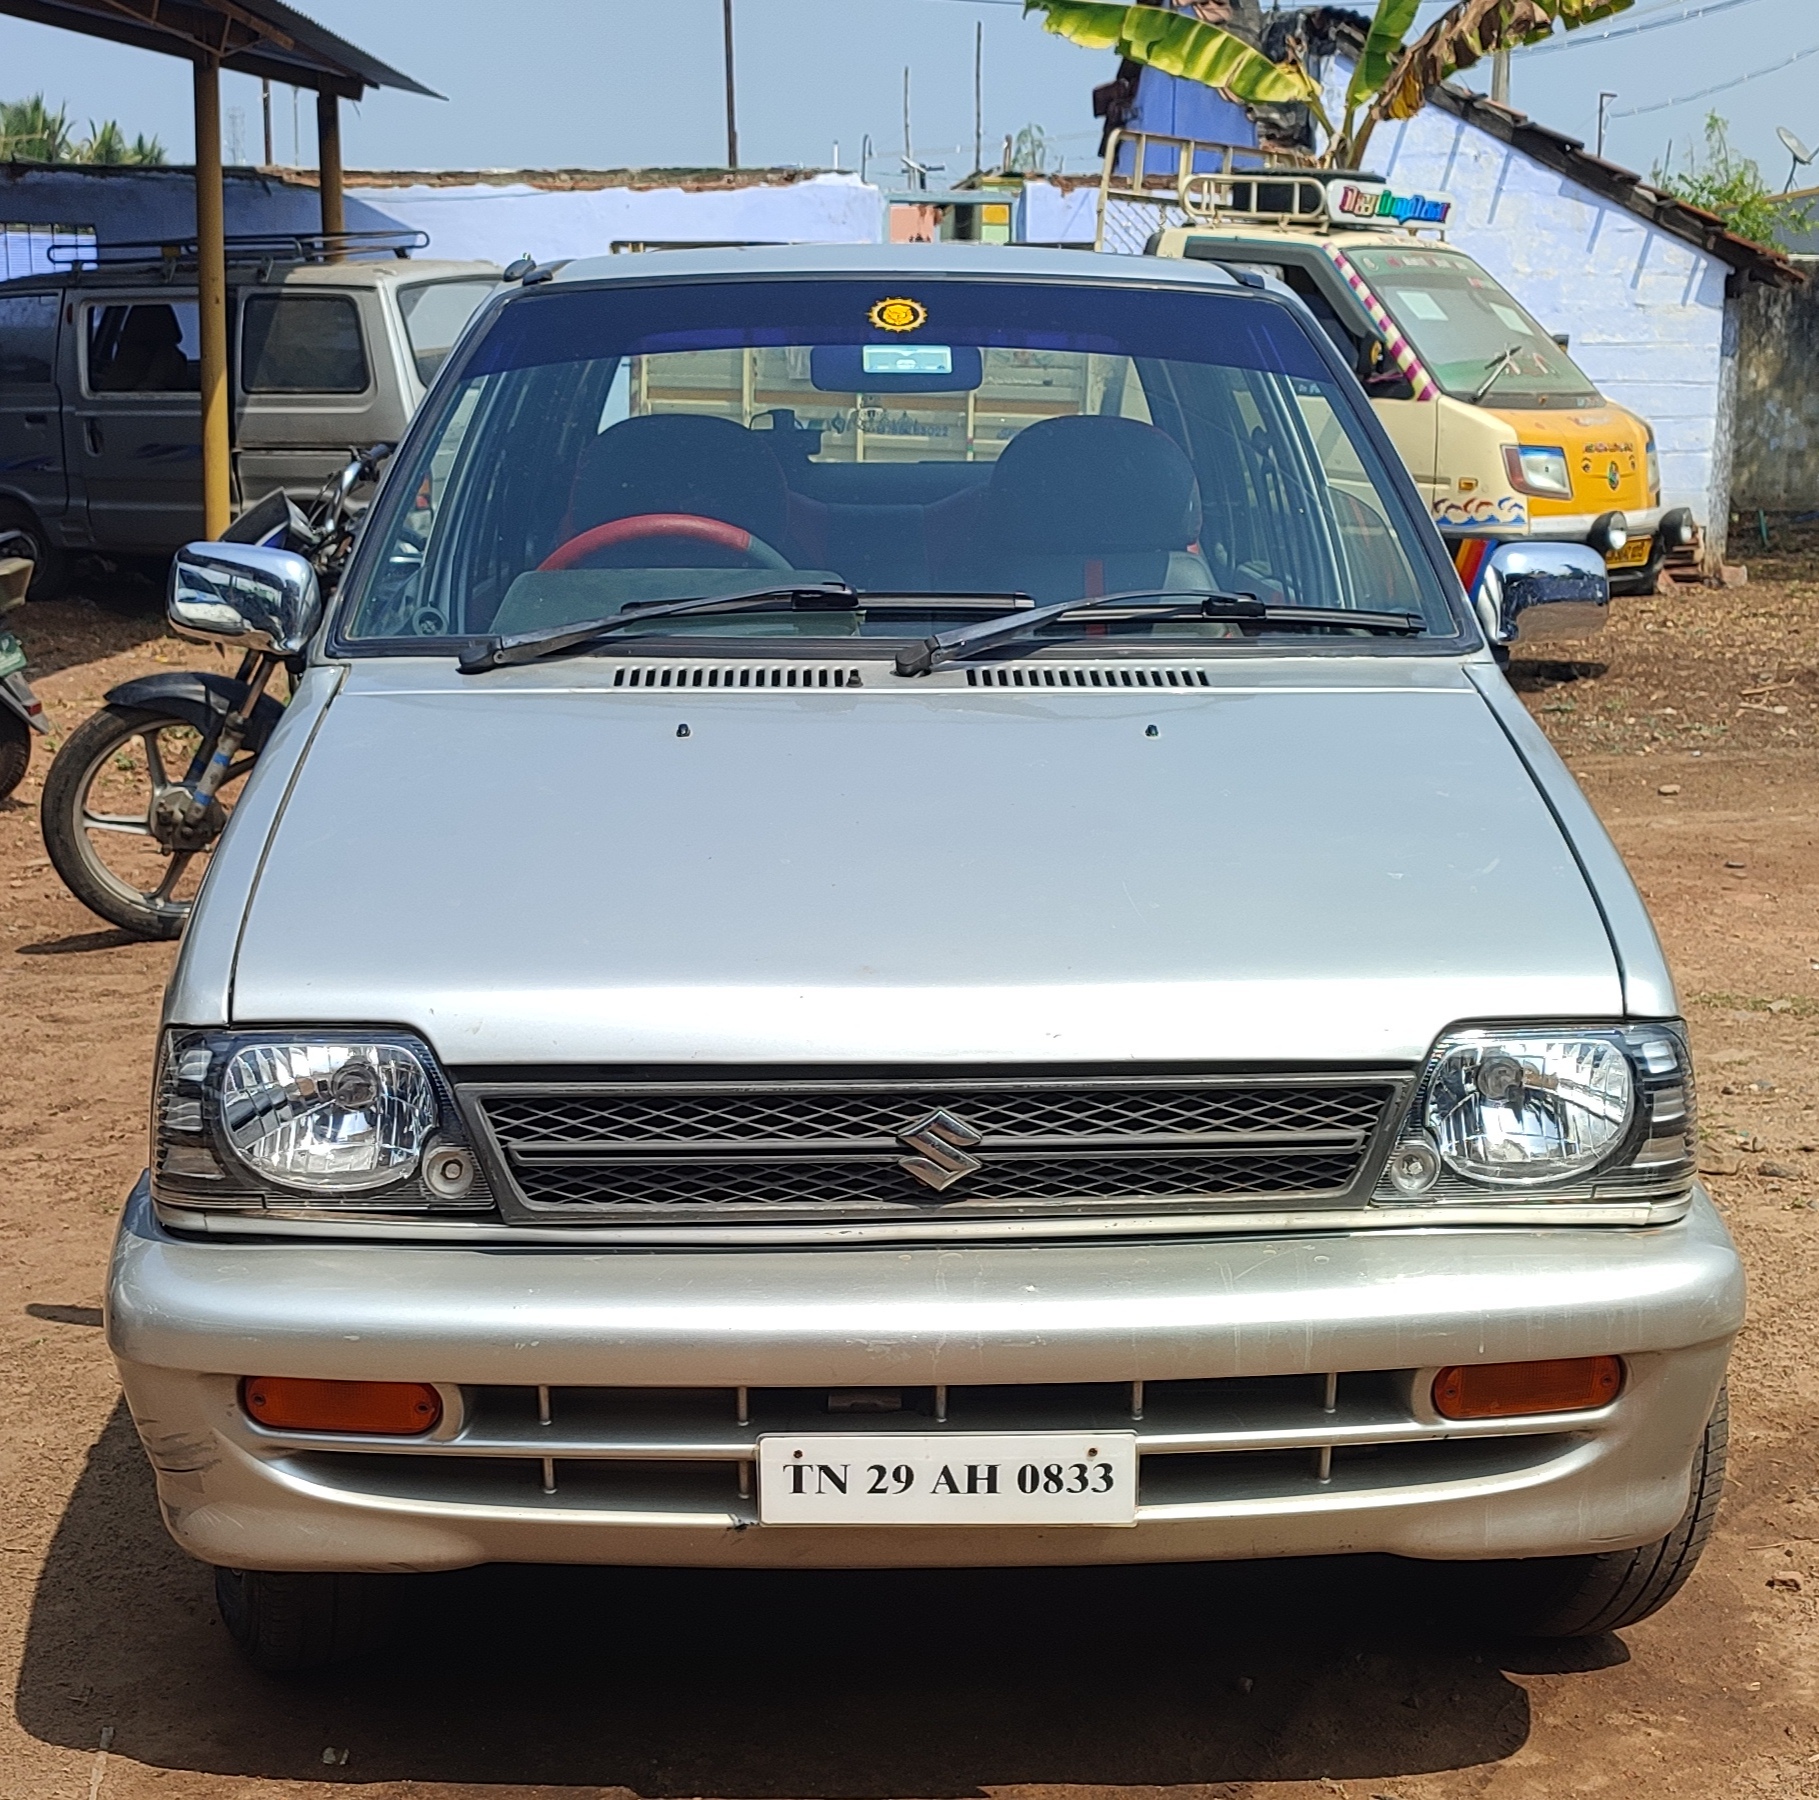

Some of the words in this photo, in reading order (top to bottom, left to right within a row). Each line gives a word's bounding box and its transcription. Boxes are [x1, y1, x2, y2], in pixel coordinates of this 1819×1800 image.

[782, 1463, 849, 1495] TN
[866, 1463, 915, 1495] 29
[930, 1463, 1001, 1495] AH
[1016, 1462, 1114, 1494] 0833
